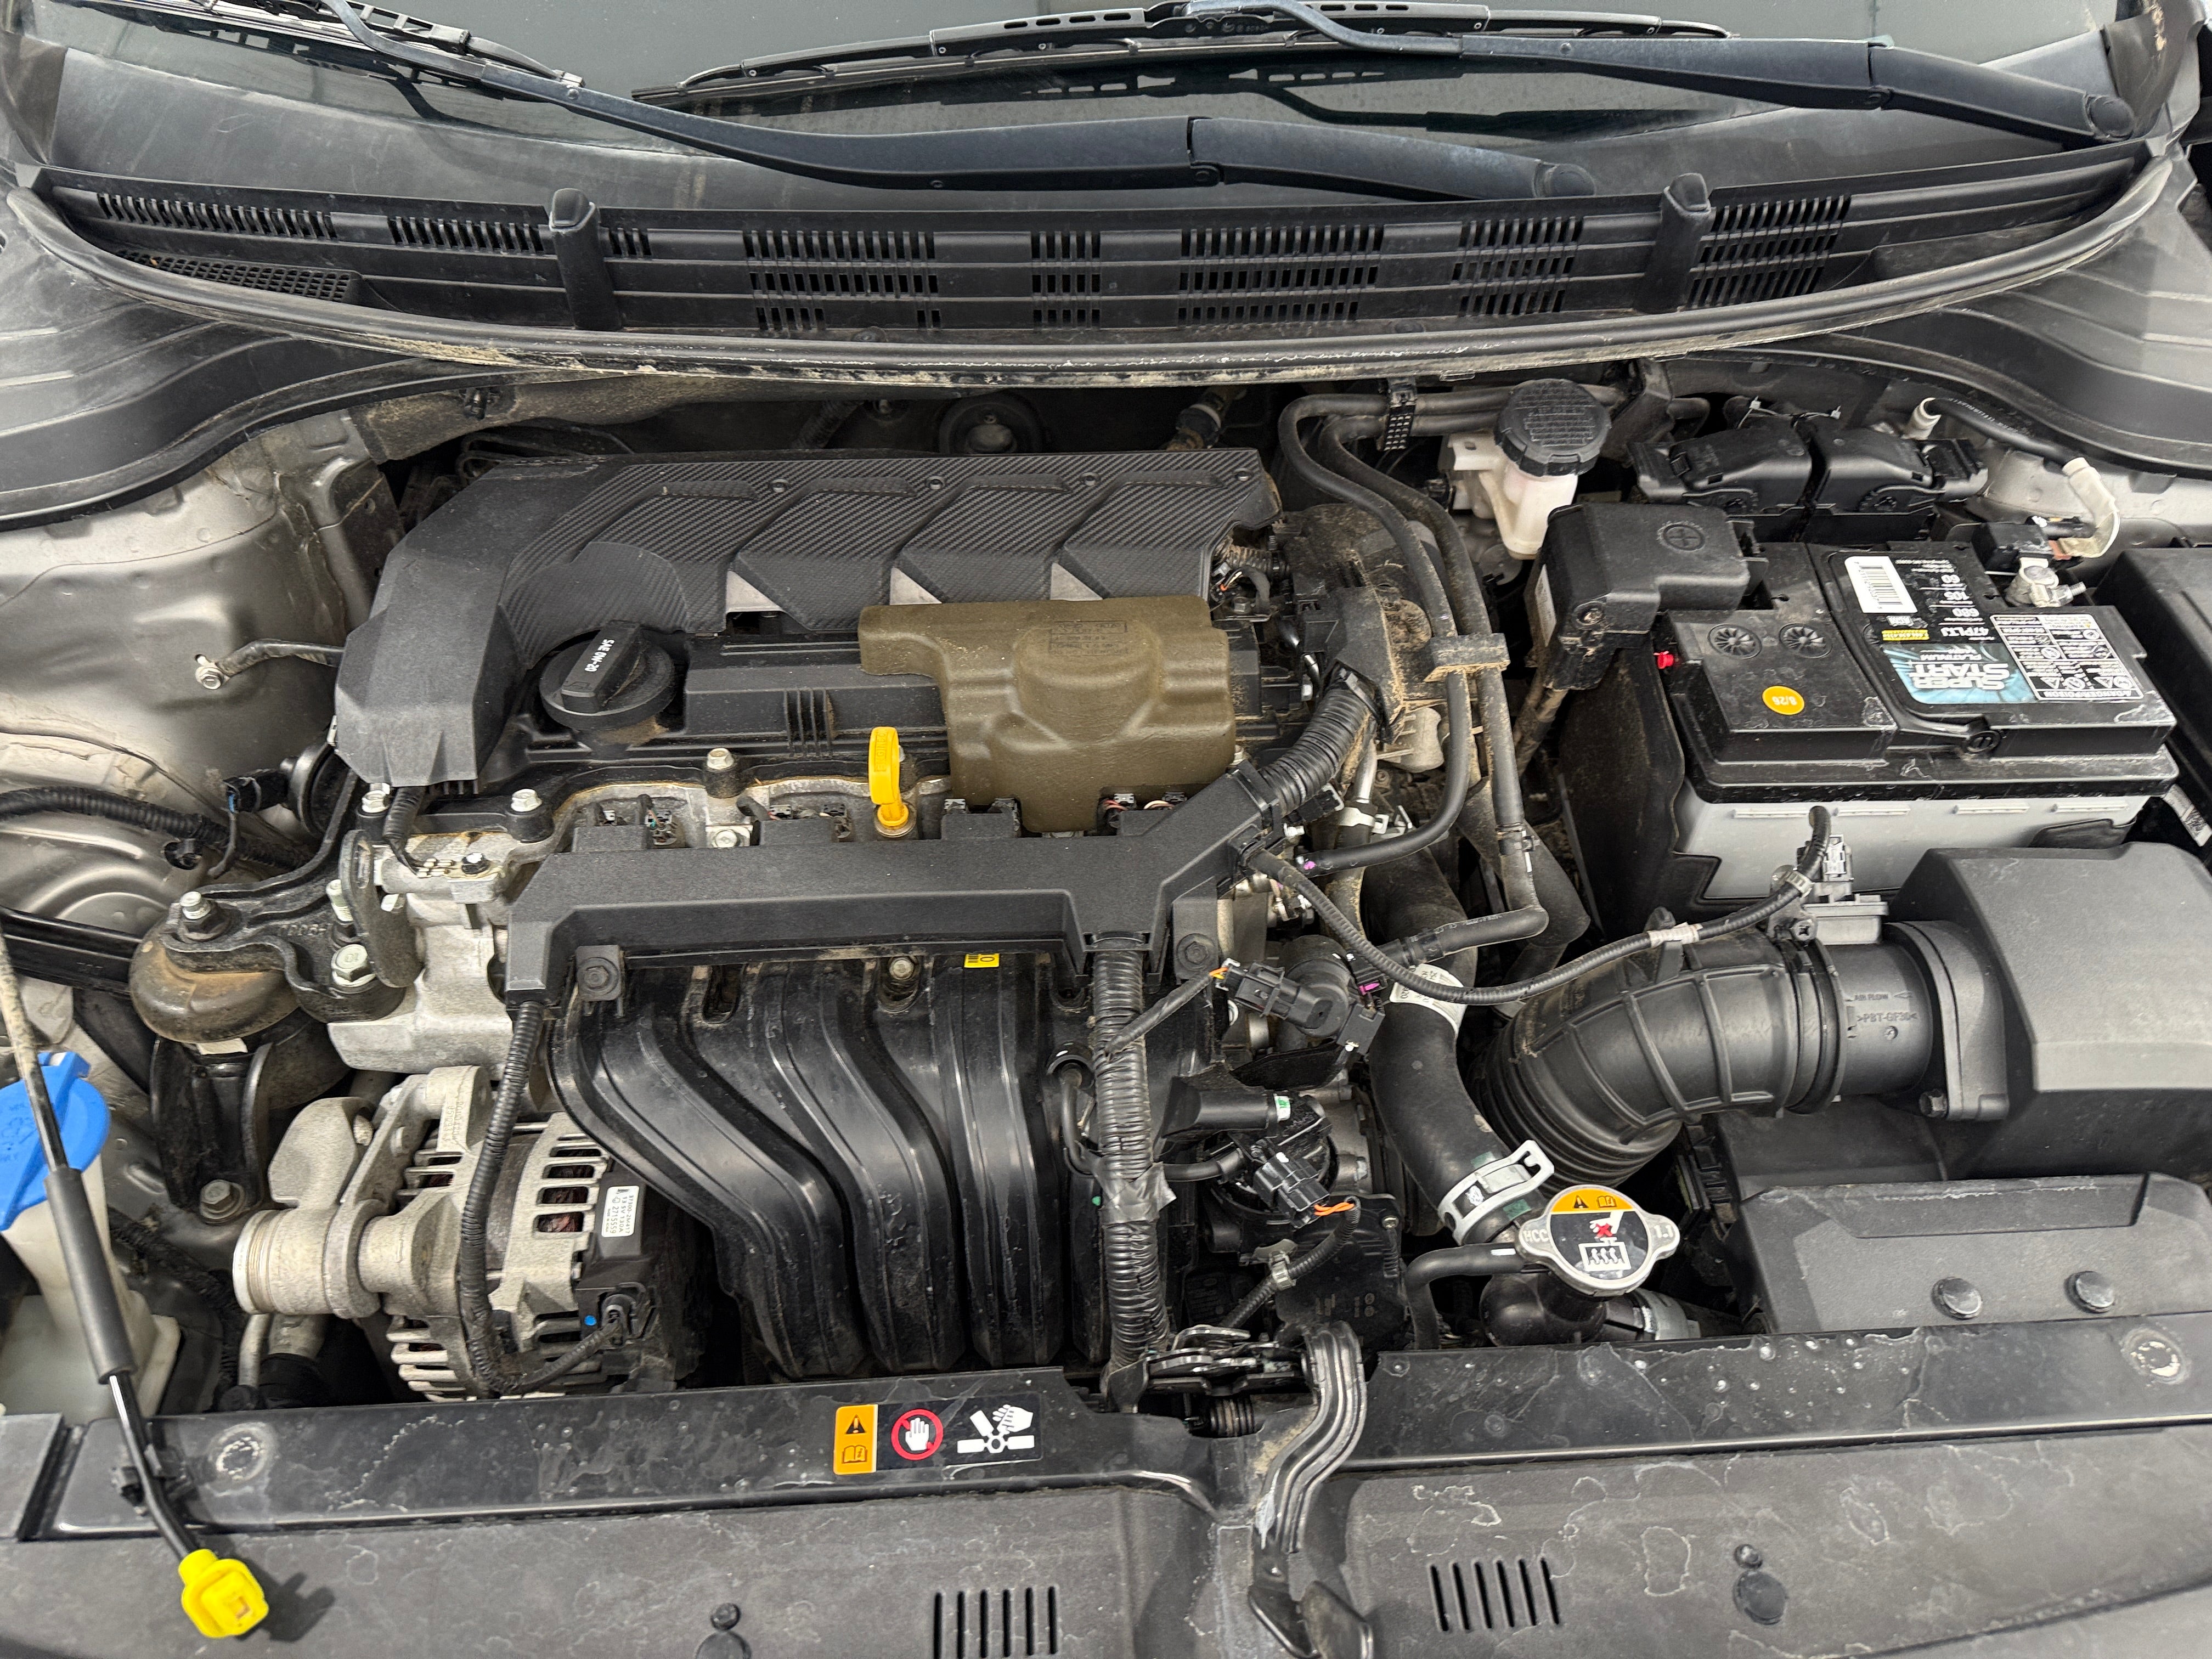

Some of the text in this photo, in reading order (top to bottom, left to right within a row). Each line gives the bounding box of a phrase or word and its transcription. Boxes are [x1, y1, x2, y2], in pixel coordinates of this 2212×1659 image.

[1944, 591, 1970, 600] 105
[1951, 608, 1980, 617] 680
[584, 639, 615, 672] SAE 0W-20
[1907, 663, 2010, 678] START
[1912, 677, 2005, 690] SUPER
[1772, 696, 1797, 706] 8/26
[610, 1206, 619, 1234] 2715559
[1522, 1229, 1550, 1243] HCC
[1653, 1224, 1674, 1238] 1.1
